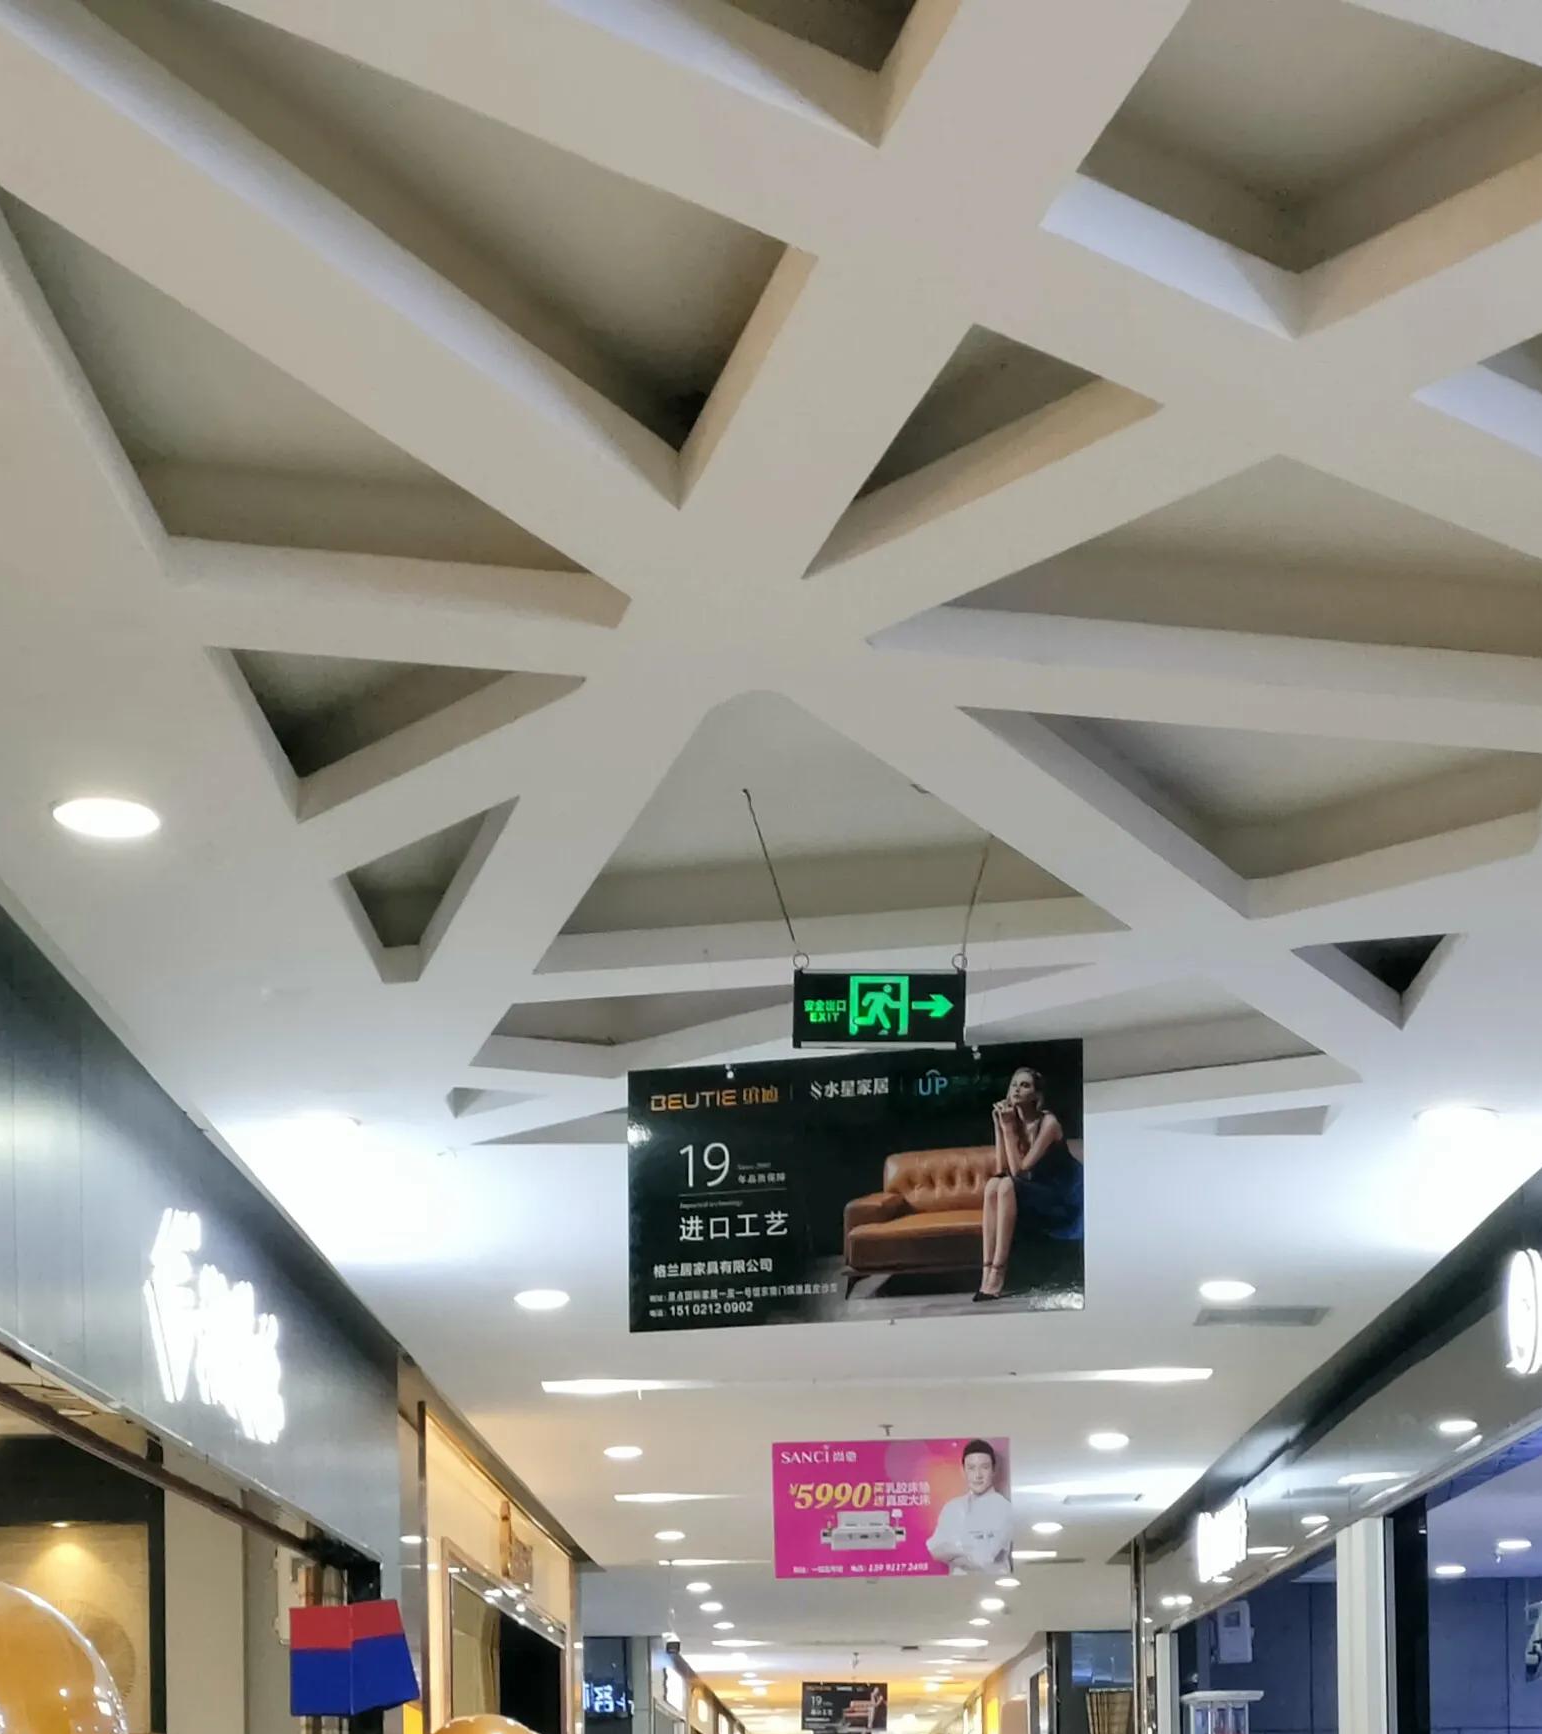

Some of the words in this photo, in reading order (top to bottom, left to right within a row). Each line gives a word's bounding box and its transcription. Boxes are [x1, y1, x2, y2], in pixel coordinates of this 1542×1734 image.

[804, 1000, 847, 1012] 安全出口
[809, 1012, 839, 1023] EXIT
[824, 1077, 889, 1099] 水星家居
[651, 1089, 738, 1112] BEUTIE
[679, 1142, 730, 1188] 19
[679, 1210, 789, 1242] 进口工艺
